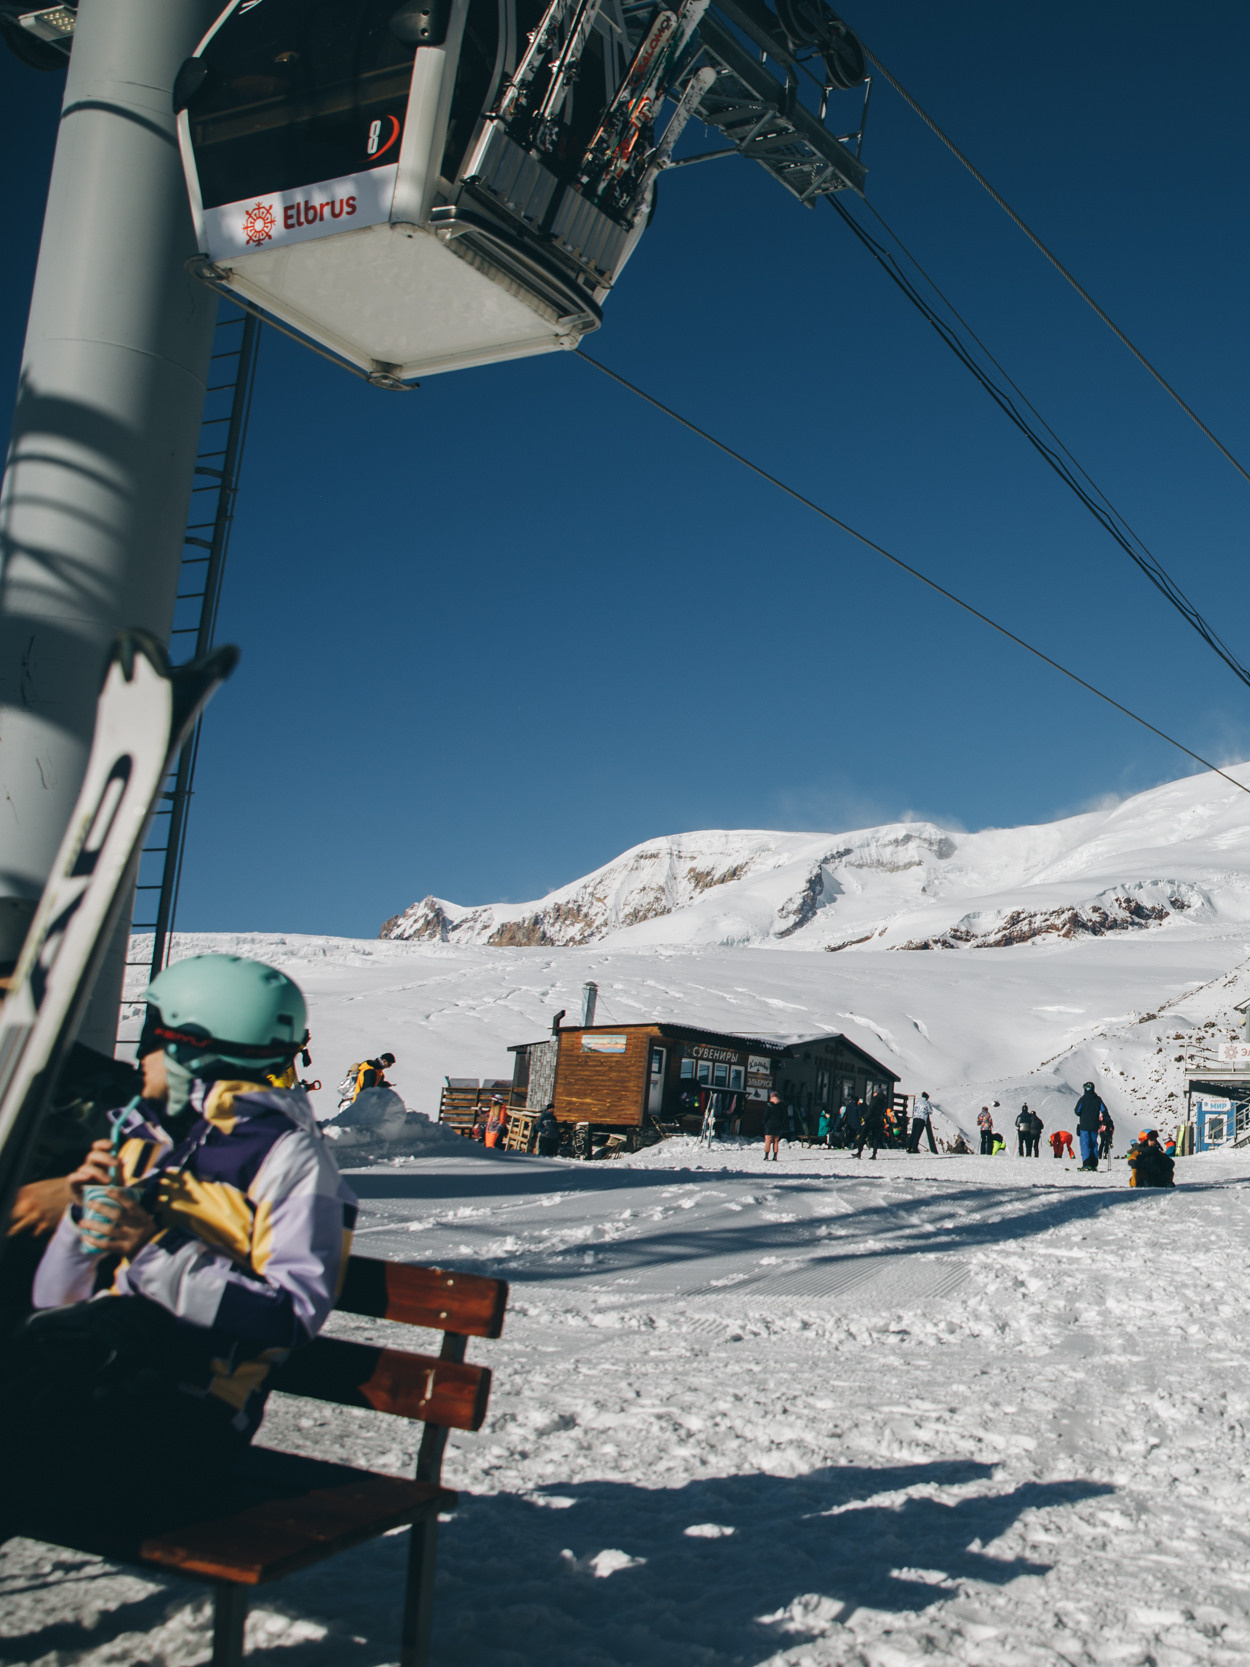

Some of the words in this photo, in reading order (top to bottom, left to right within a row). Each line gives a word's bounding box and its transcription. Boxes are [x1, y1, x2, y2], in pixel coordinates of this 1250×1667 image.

[367, 120, 382, 155] 8
[283, 196, 357, 230] Elbrus
[692, 1046, 739, 1062] СУВЕНИРЫ
